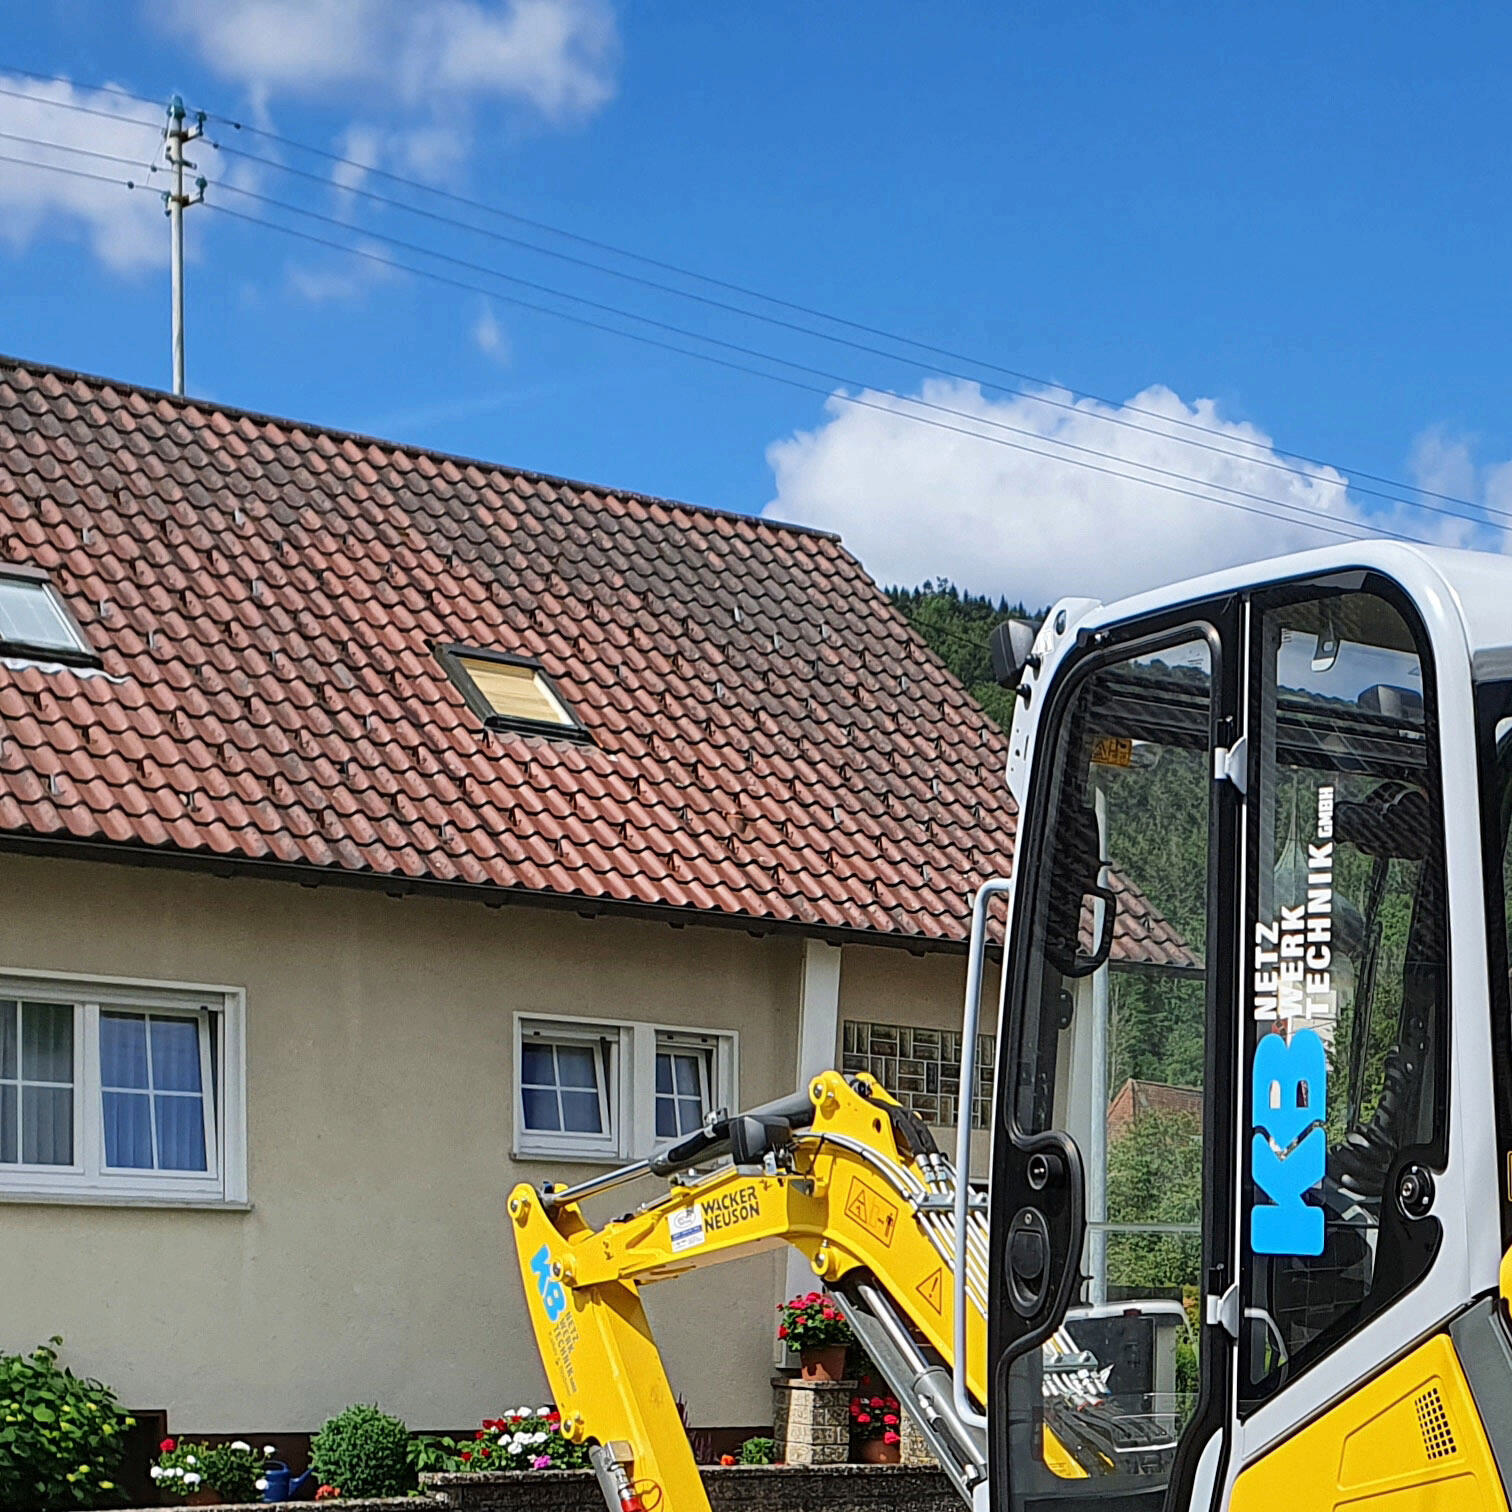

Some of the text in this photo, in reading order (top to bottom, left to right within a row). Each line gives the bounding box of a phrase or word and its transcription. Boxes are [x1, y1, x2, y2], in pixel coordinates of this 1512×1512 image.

[1306, 786, 1334, 1019] TECHNIK GMBH
[1255, 921, 1279, 1020] NETZ
[1280, 904, 1305, 1019] WERK
[1251, 1028, 1327, 1255] KB
[701, 1186, 757, 1216] WACKER
[704, 1201, 760, 1232] NEUSON
